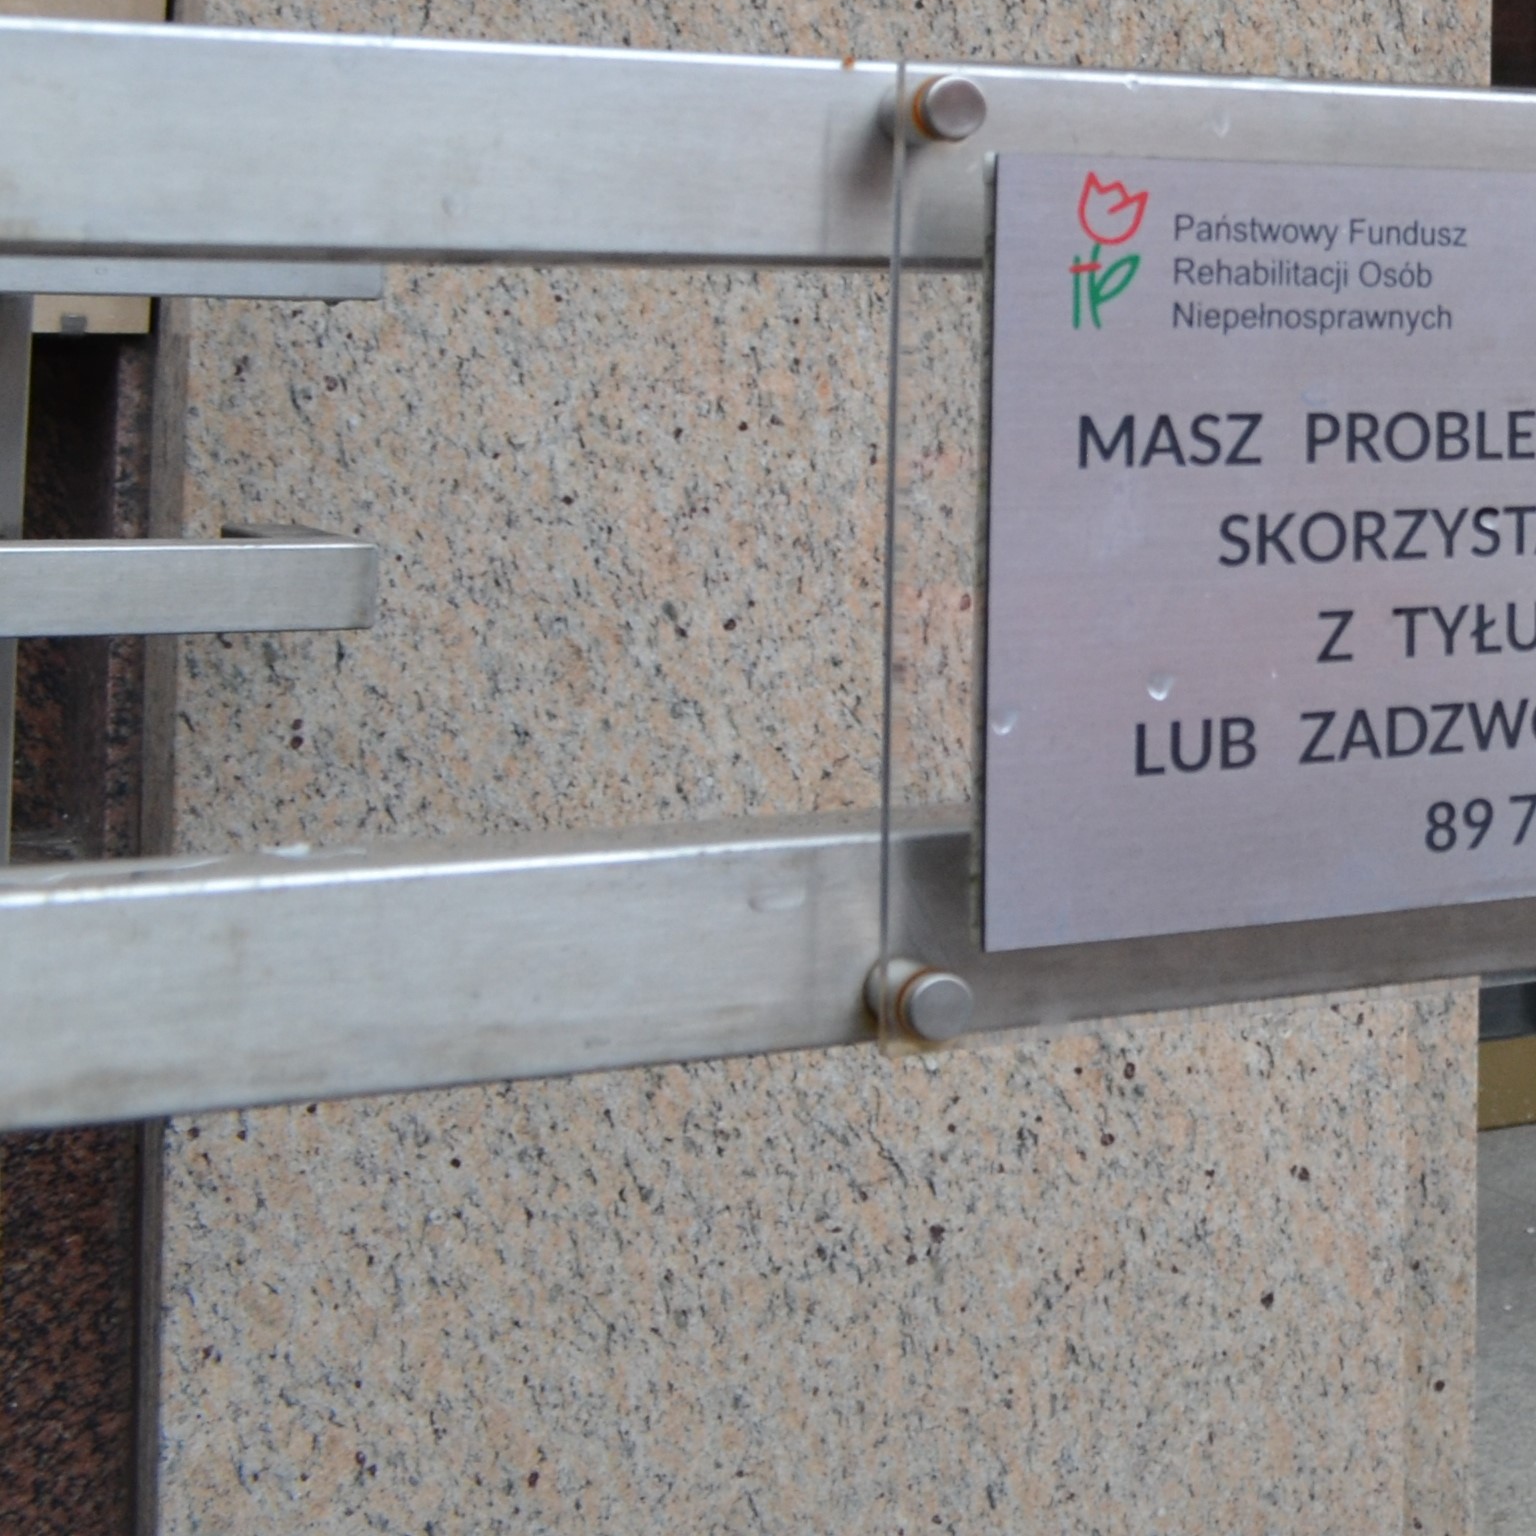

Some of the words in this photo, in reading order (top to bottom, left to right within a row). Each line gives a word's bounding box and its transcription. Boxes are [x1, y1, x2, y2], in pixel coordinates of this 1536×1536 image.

[1173, 213, 1339, 252] Państwowy
[1349, 217, 1468, 248] Fundusz
[1173, 257, 1349, 295] Rehabilitacji
[1358, 260, 1433, 289] Osób
[1172, 302, 1453, 336] Niepełnosprawnych
[1078, 412, 1264, 470] MASZ
[1317, 610, 1355, 664] Z
[1134, 716, 1258, 777] LUB
[1424, 798, 1494, 854] 89
